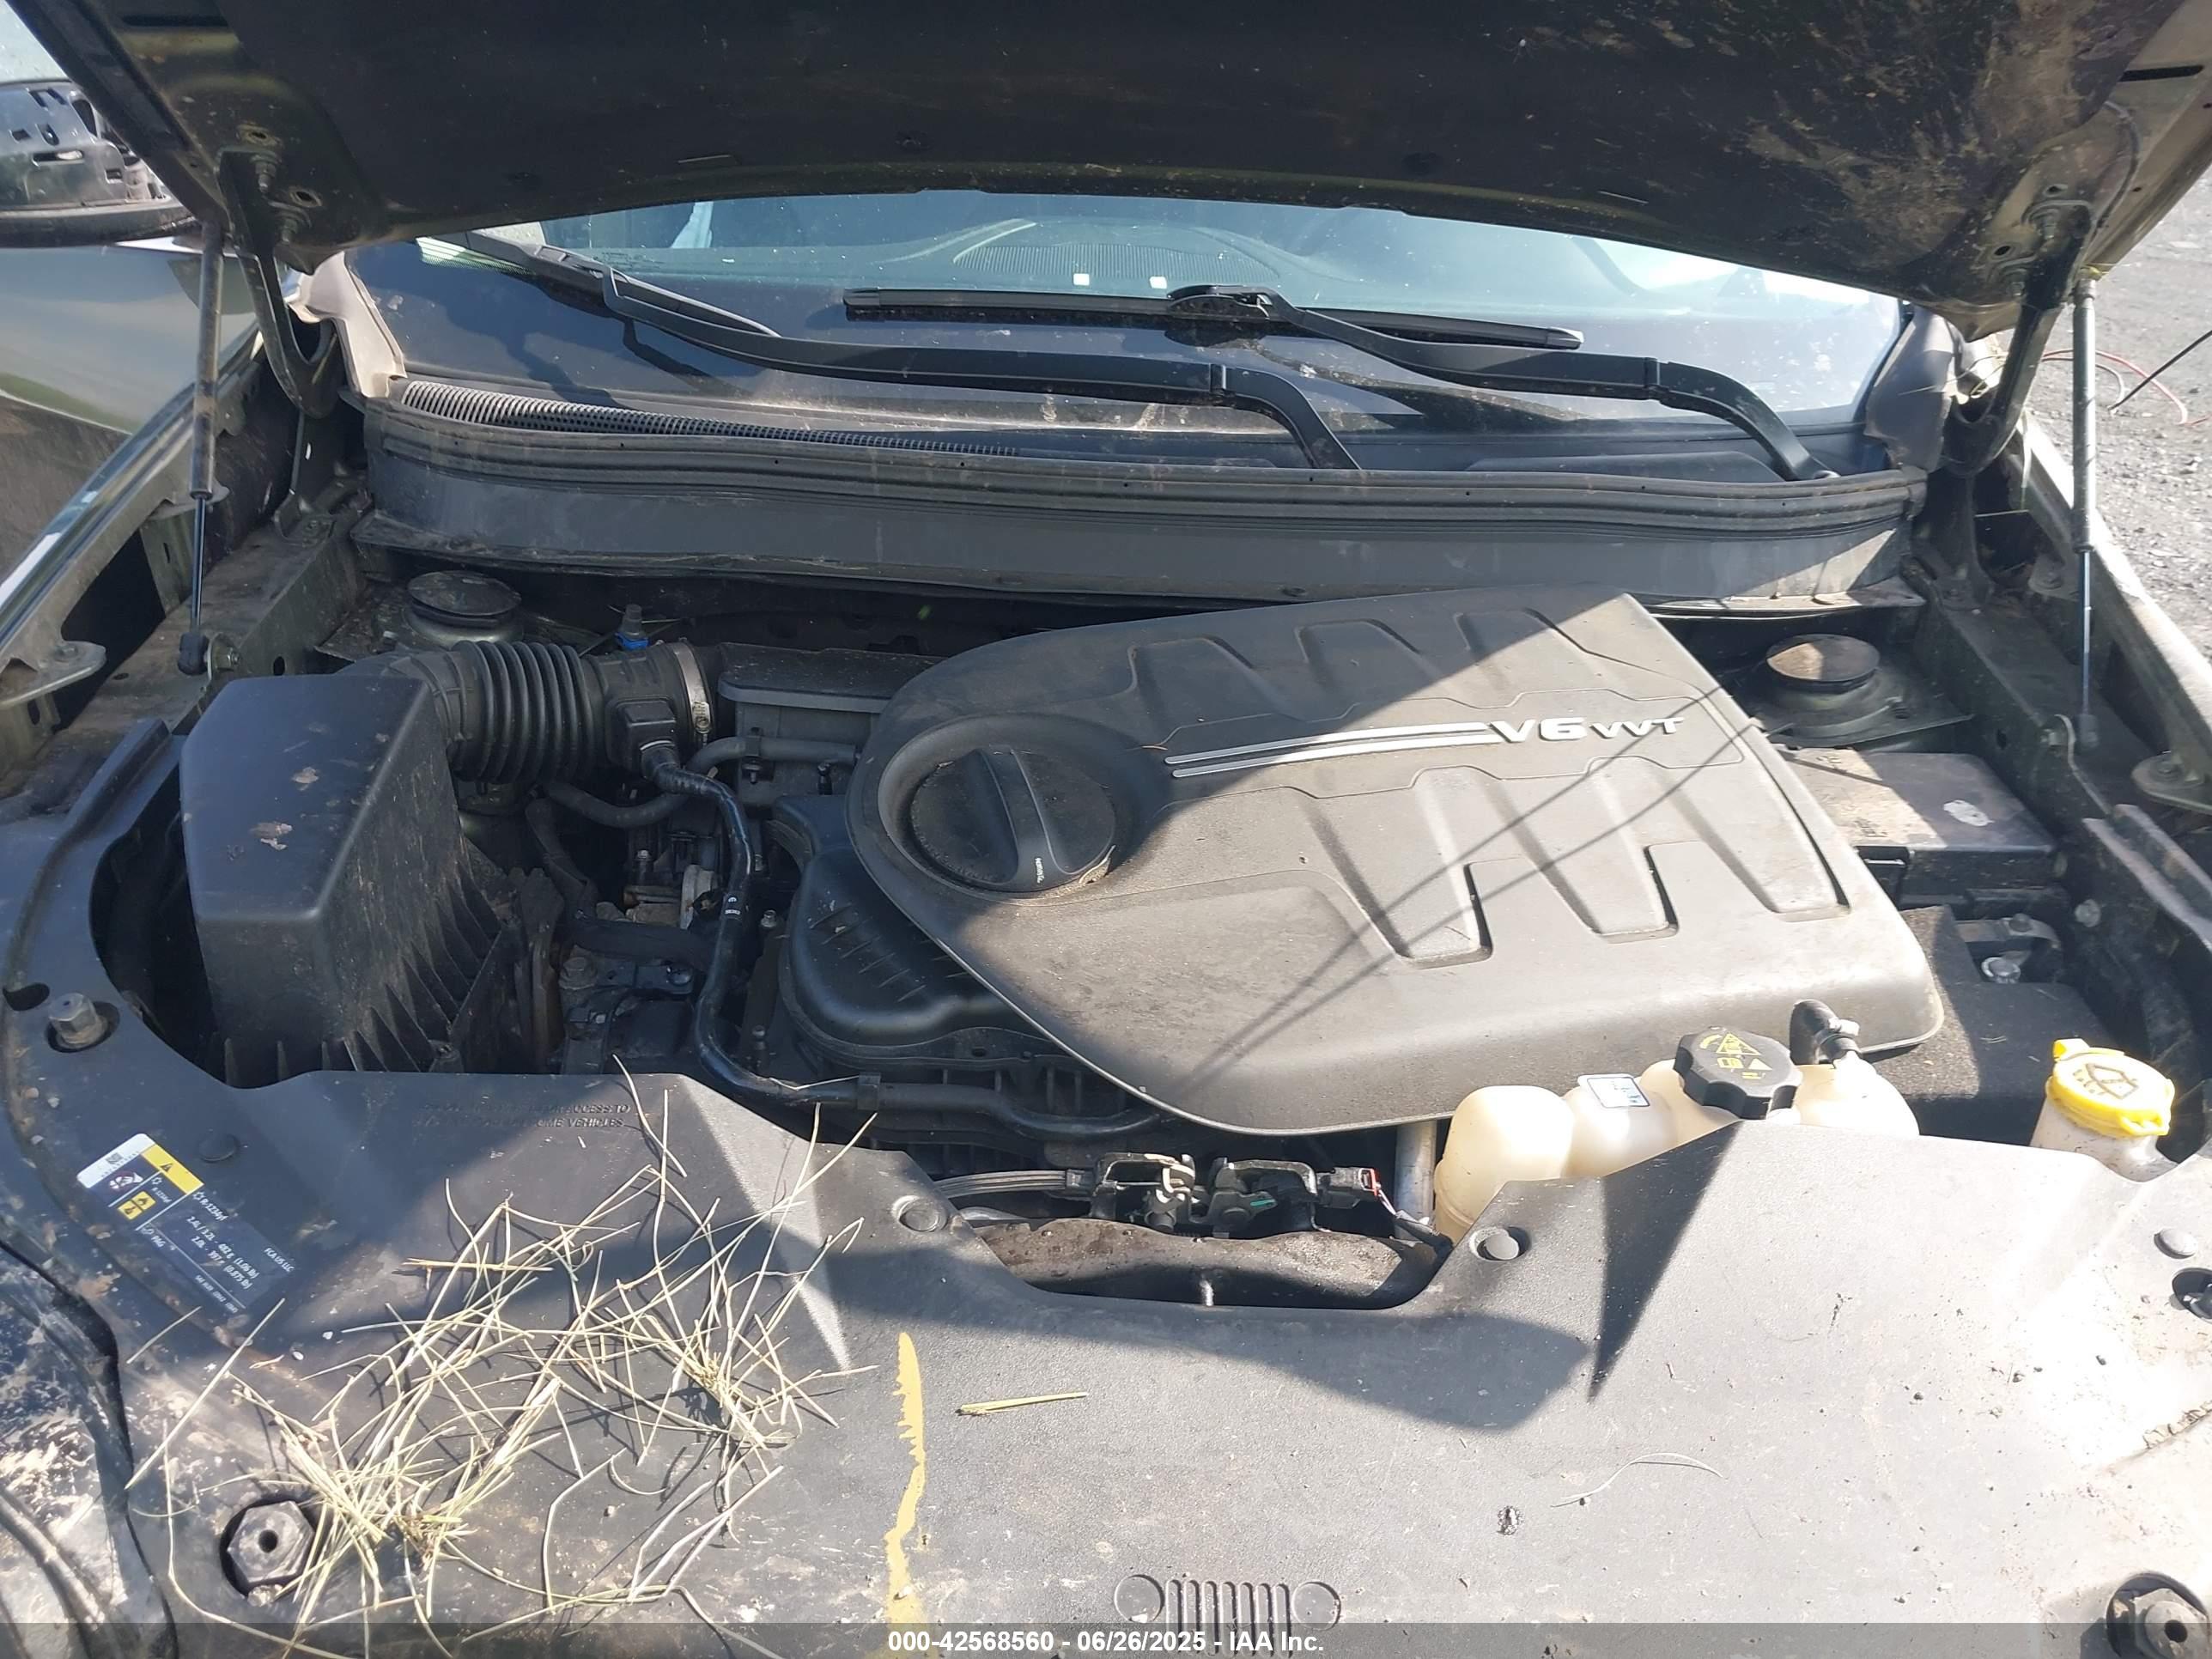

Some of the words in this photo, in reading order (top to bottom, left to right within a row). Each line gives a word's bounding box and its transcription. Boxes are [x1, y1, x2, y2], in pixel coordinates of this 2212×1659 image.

[1490, 717, 1588, 744] V6
[1589, 716, 1686, 739] VVT
[615, 1105, 632, 1114] TO
[568, 1118, 624, 1127] VEHICLES
